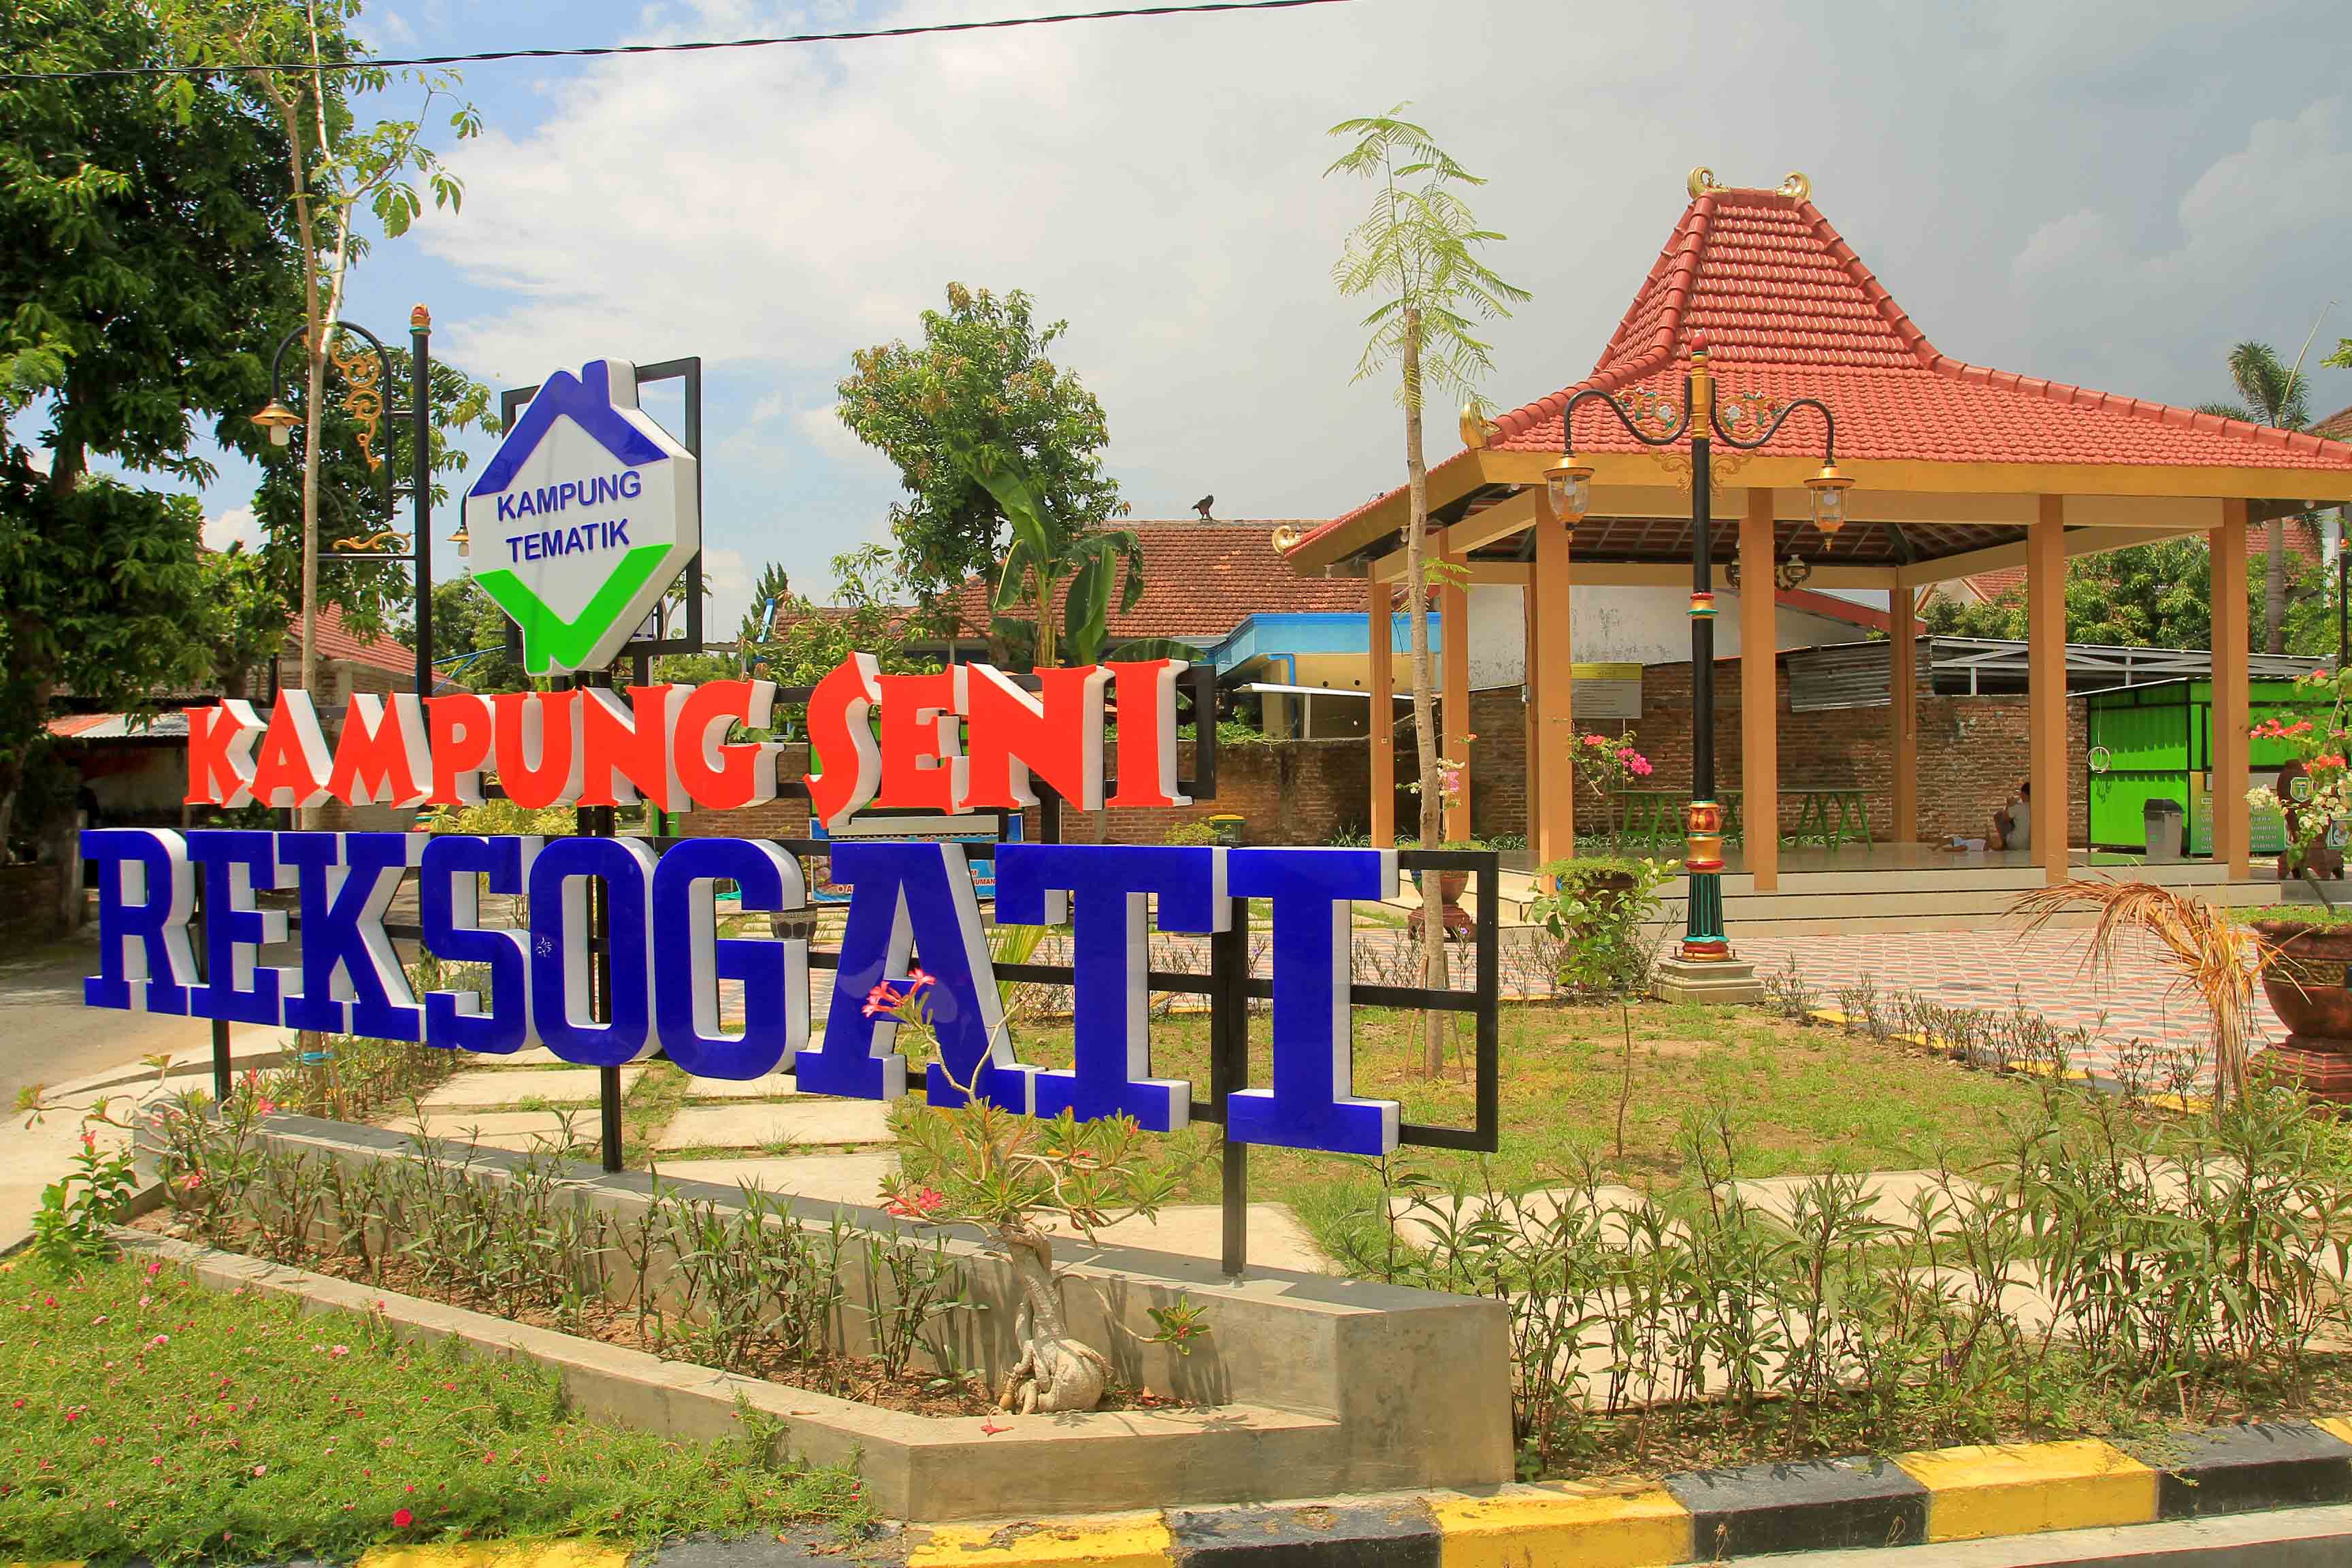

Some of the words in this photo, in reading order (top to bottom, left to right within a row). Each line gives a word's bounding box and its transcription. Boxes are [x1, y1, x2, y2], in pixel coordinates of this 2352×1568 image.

[497, 470, 642, 521] KAMPUNG
[506, 518, 630, 564] TEMATIK
[182, 680, 762, 815] KAMPUNG
[802, 651, 1174, 829] SENI
[80, 830, 1384, 1157] REKSOGATI
